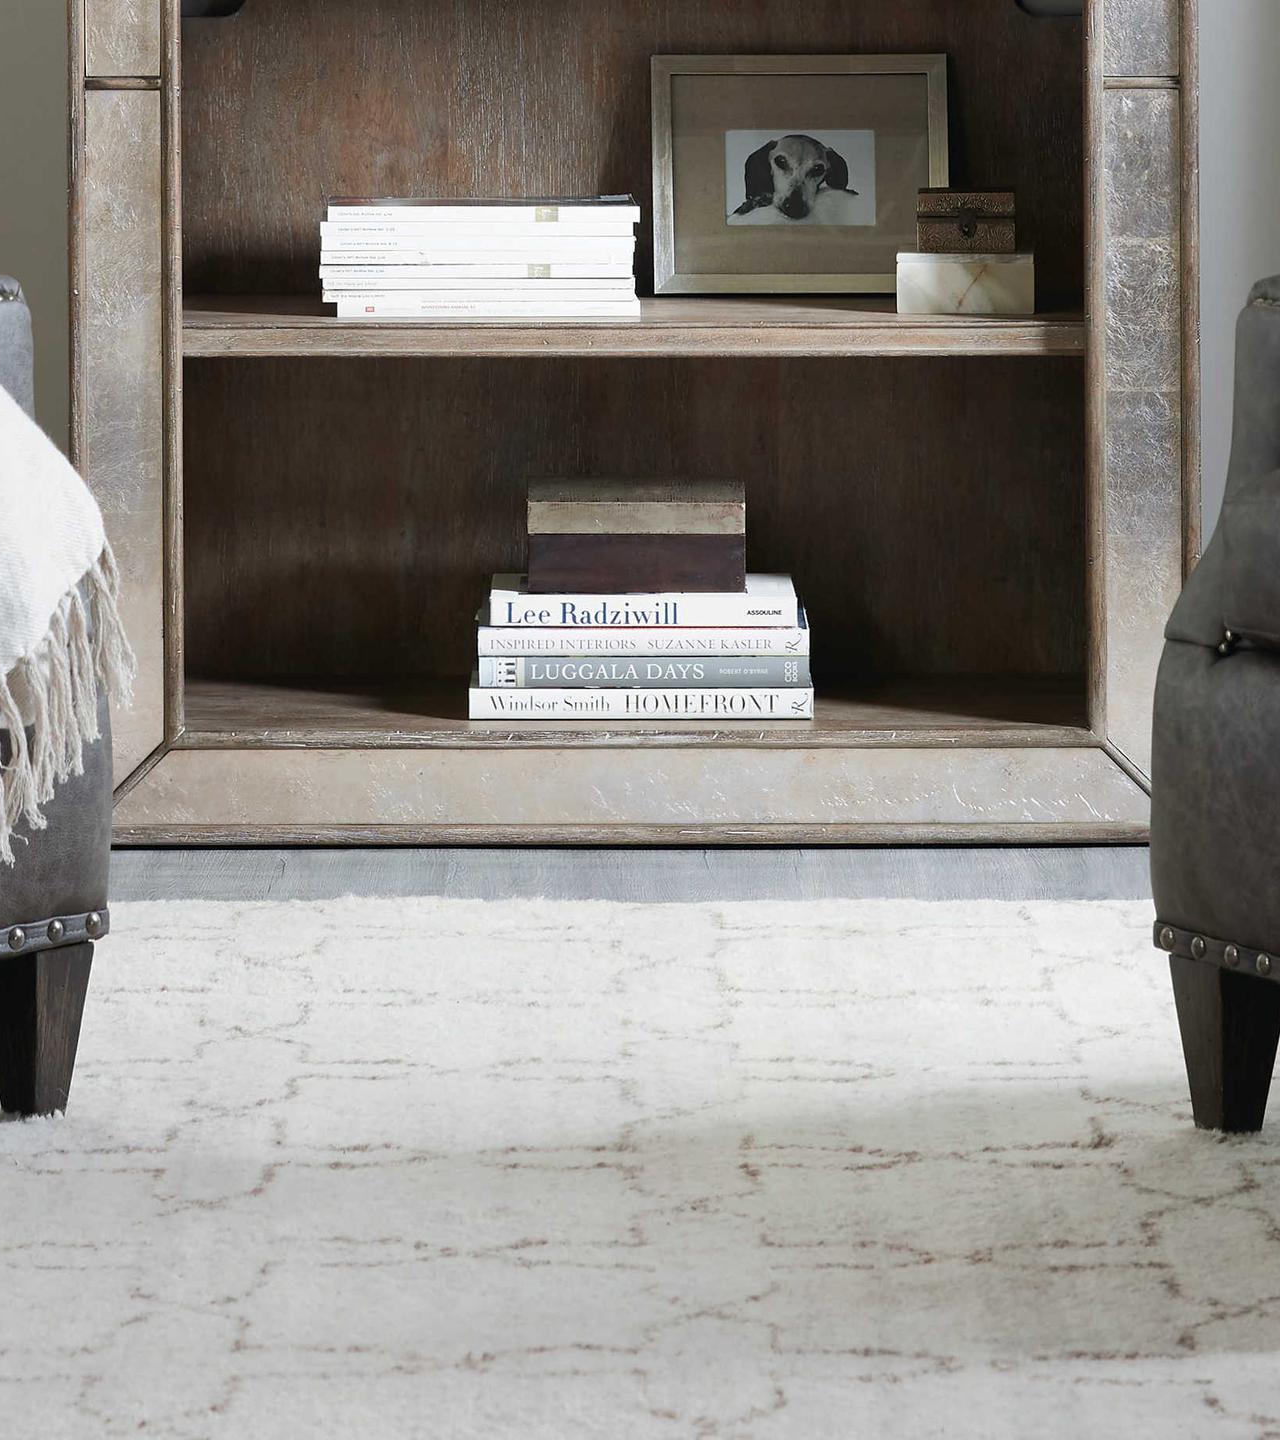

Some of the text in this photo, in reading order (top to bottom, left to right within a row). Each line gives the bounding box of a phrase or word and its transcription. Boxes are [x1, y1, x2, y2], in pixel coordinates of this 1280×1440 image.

[505, 602, 679, 625] Lee Radziwill
[489, 638, 773, 651] INSPIRED INTERIORS SUZANNE KASLER
[530, 663, 705, 681] LUGGALA DAYS
[784, 661, 792, 683] CICO
[489, 693, 780, 714] Windsor Smith HOMEFRONT
